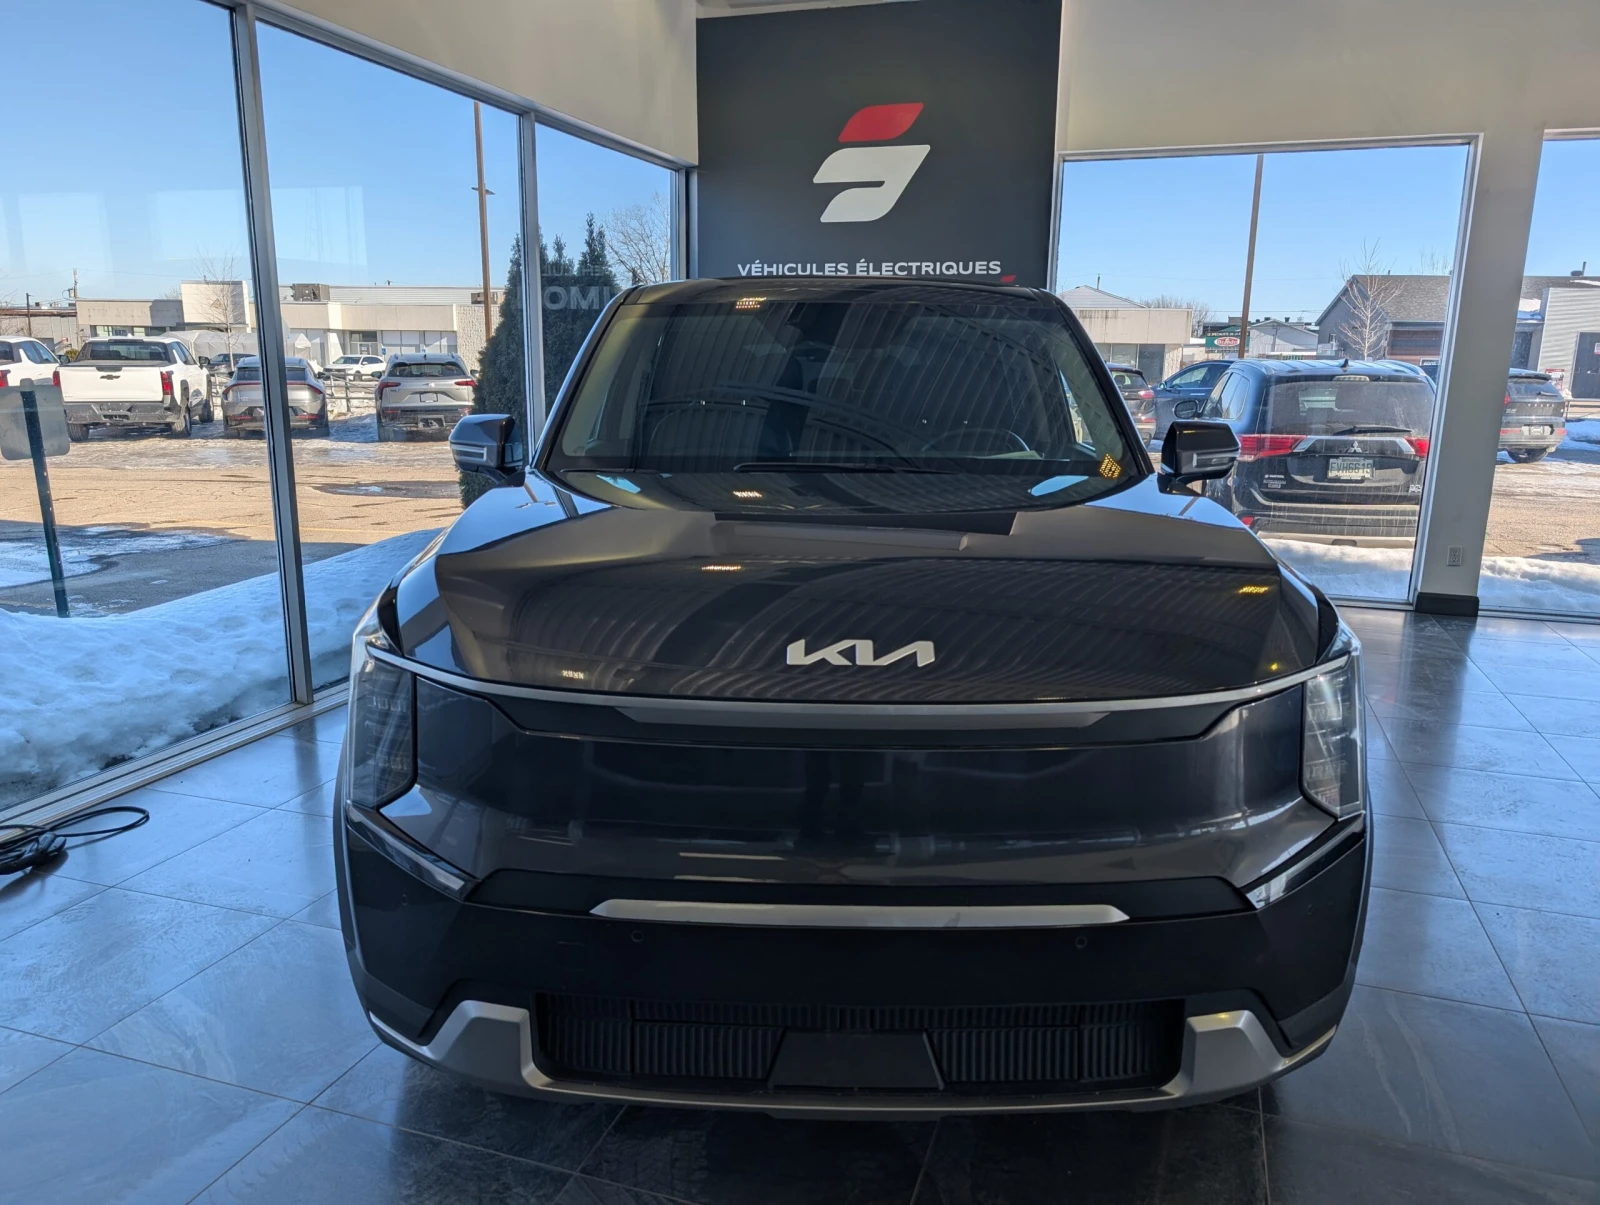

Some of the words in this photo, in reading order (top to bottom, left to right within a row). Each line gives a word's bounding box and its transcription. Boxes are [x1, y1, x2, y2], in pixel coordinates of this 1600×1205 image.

[737, 260, 849, 276] VÉHICULES
[855, 258, 1001, 275] ÉLECTRIQUES
[787, 639, 935, 667] KIA
